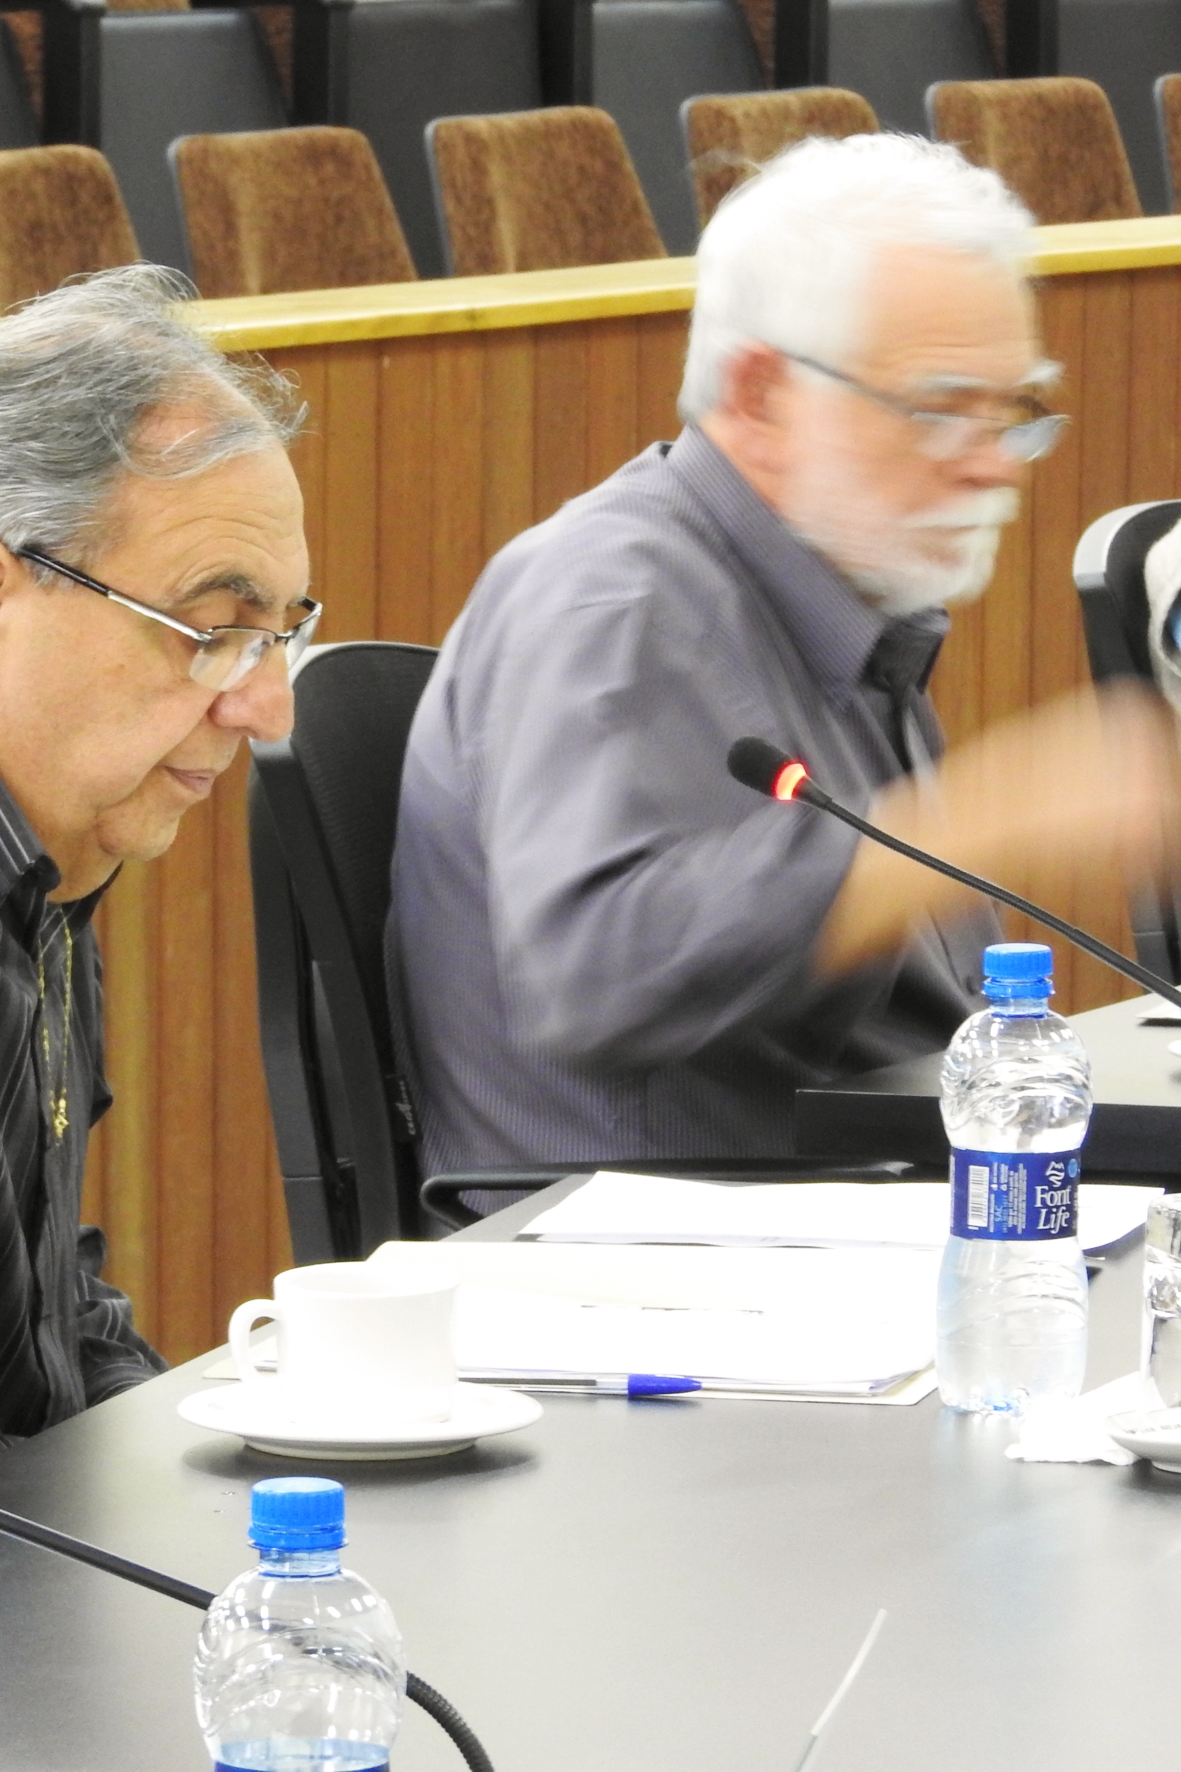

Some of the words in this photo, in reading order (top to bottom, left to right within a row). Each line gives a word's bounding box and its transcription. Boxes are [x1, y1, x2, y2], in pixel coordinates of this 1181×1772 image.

[1034, 1185, 1071, 1207] Font
[994, 1205, 1003, 1221] SAC
[1036, 1206, 1070, 1234] Life
